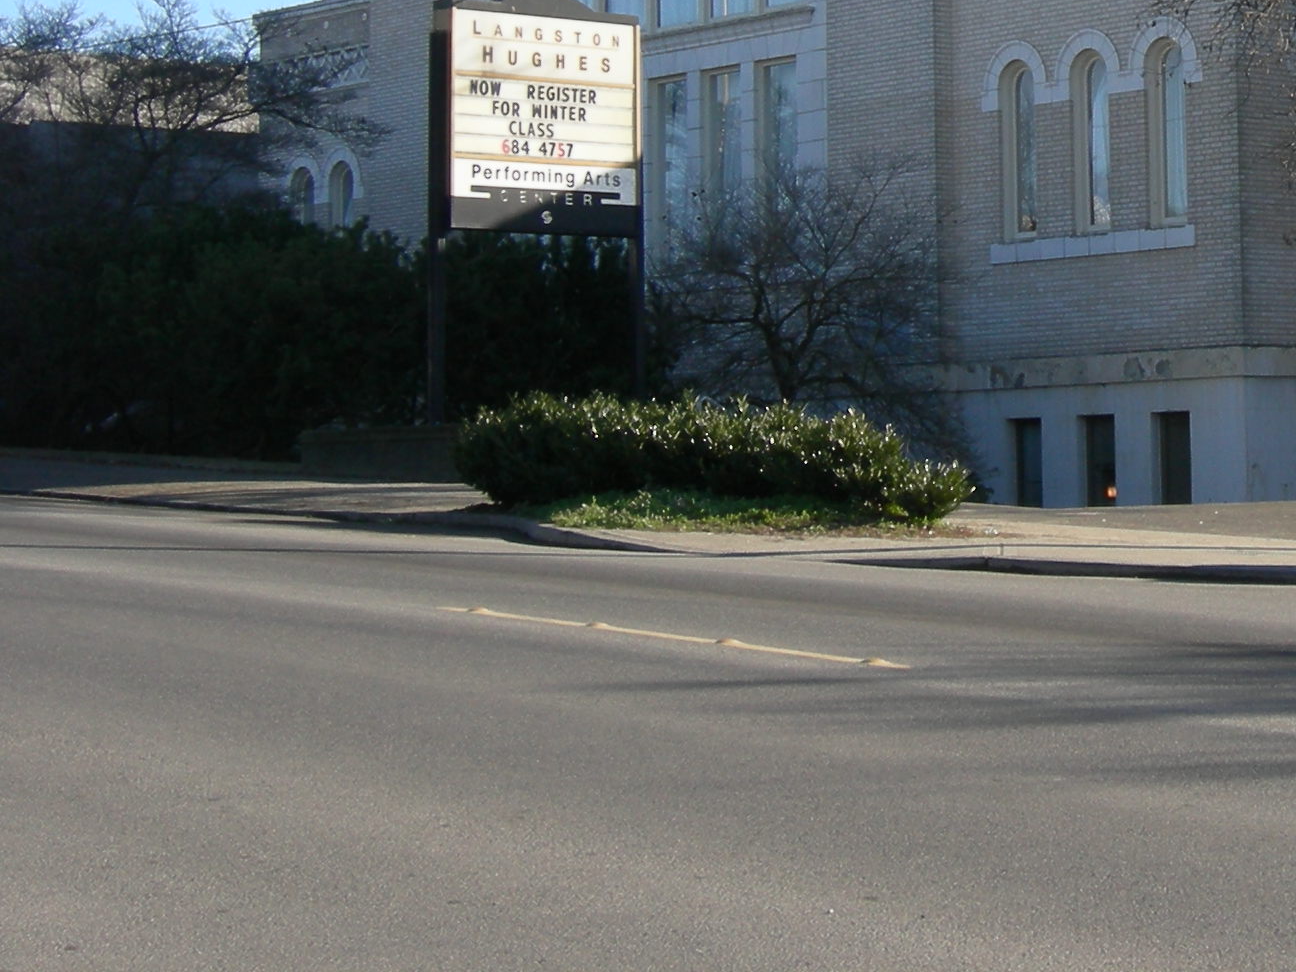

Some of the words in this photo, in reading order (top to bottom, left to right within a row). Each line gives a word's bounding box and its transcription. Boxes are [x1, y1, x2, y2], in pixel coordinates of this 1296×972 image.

[473, 20, 620, 47] LANGSTON
[482, 45, 611, 73] HUGHES
[470, 80, 501, 96] NOW
[527, 84, 597, 104] REGISTER
[492, 100, 520, 117] FOR
[532, 103, 586, 121] WINTER
[509, 121, 554, 138] CLASS
[502, 139, 530, 155] 684
[539, 141, 573, 158] 4757
[472, 164, 575, 187] Performing
[584, 171, 621, 187] Arts
[500, 189, 593, 206] CENTER
